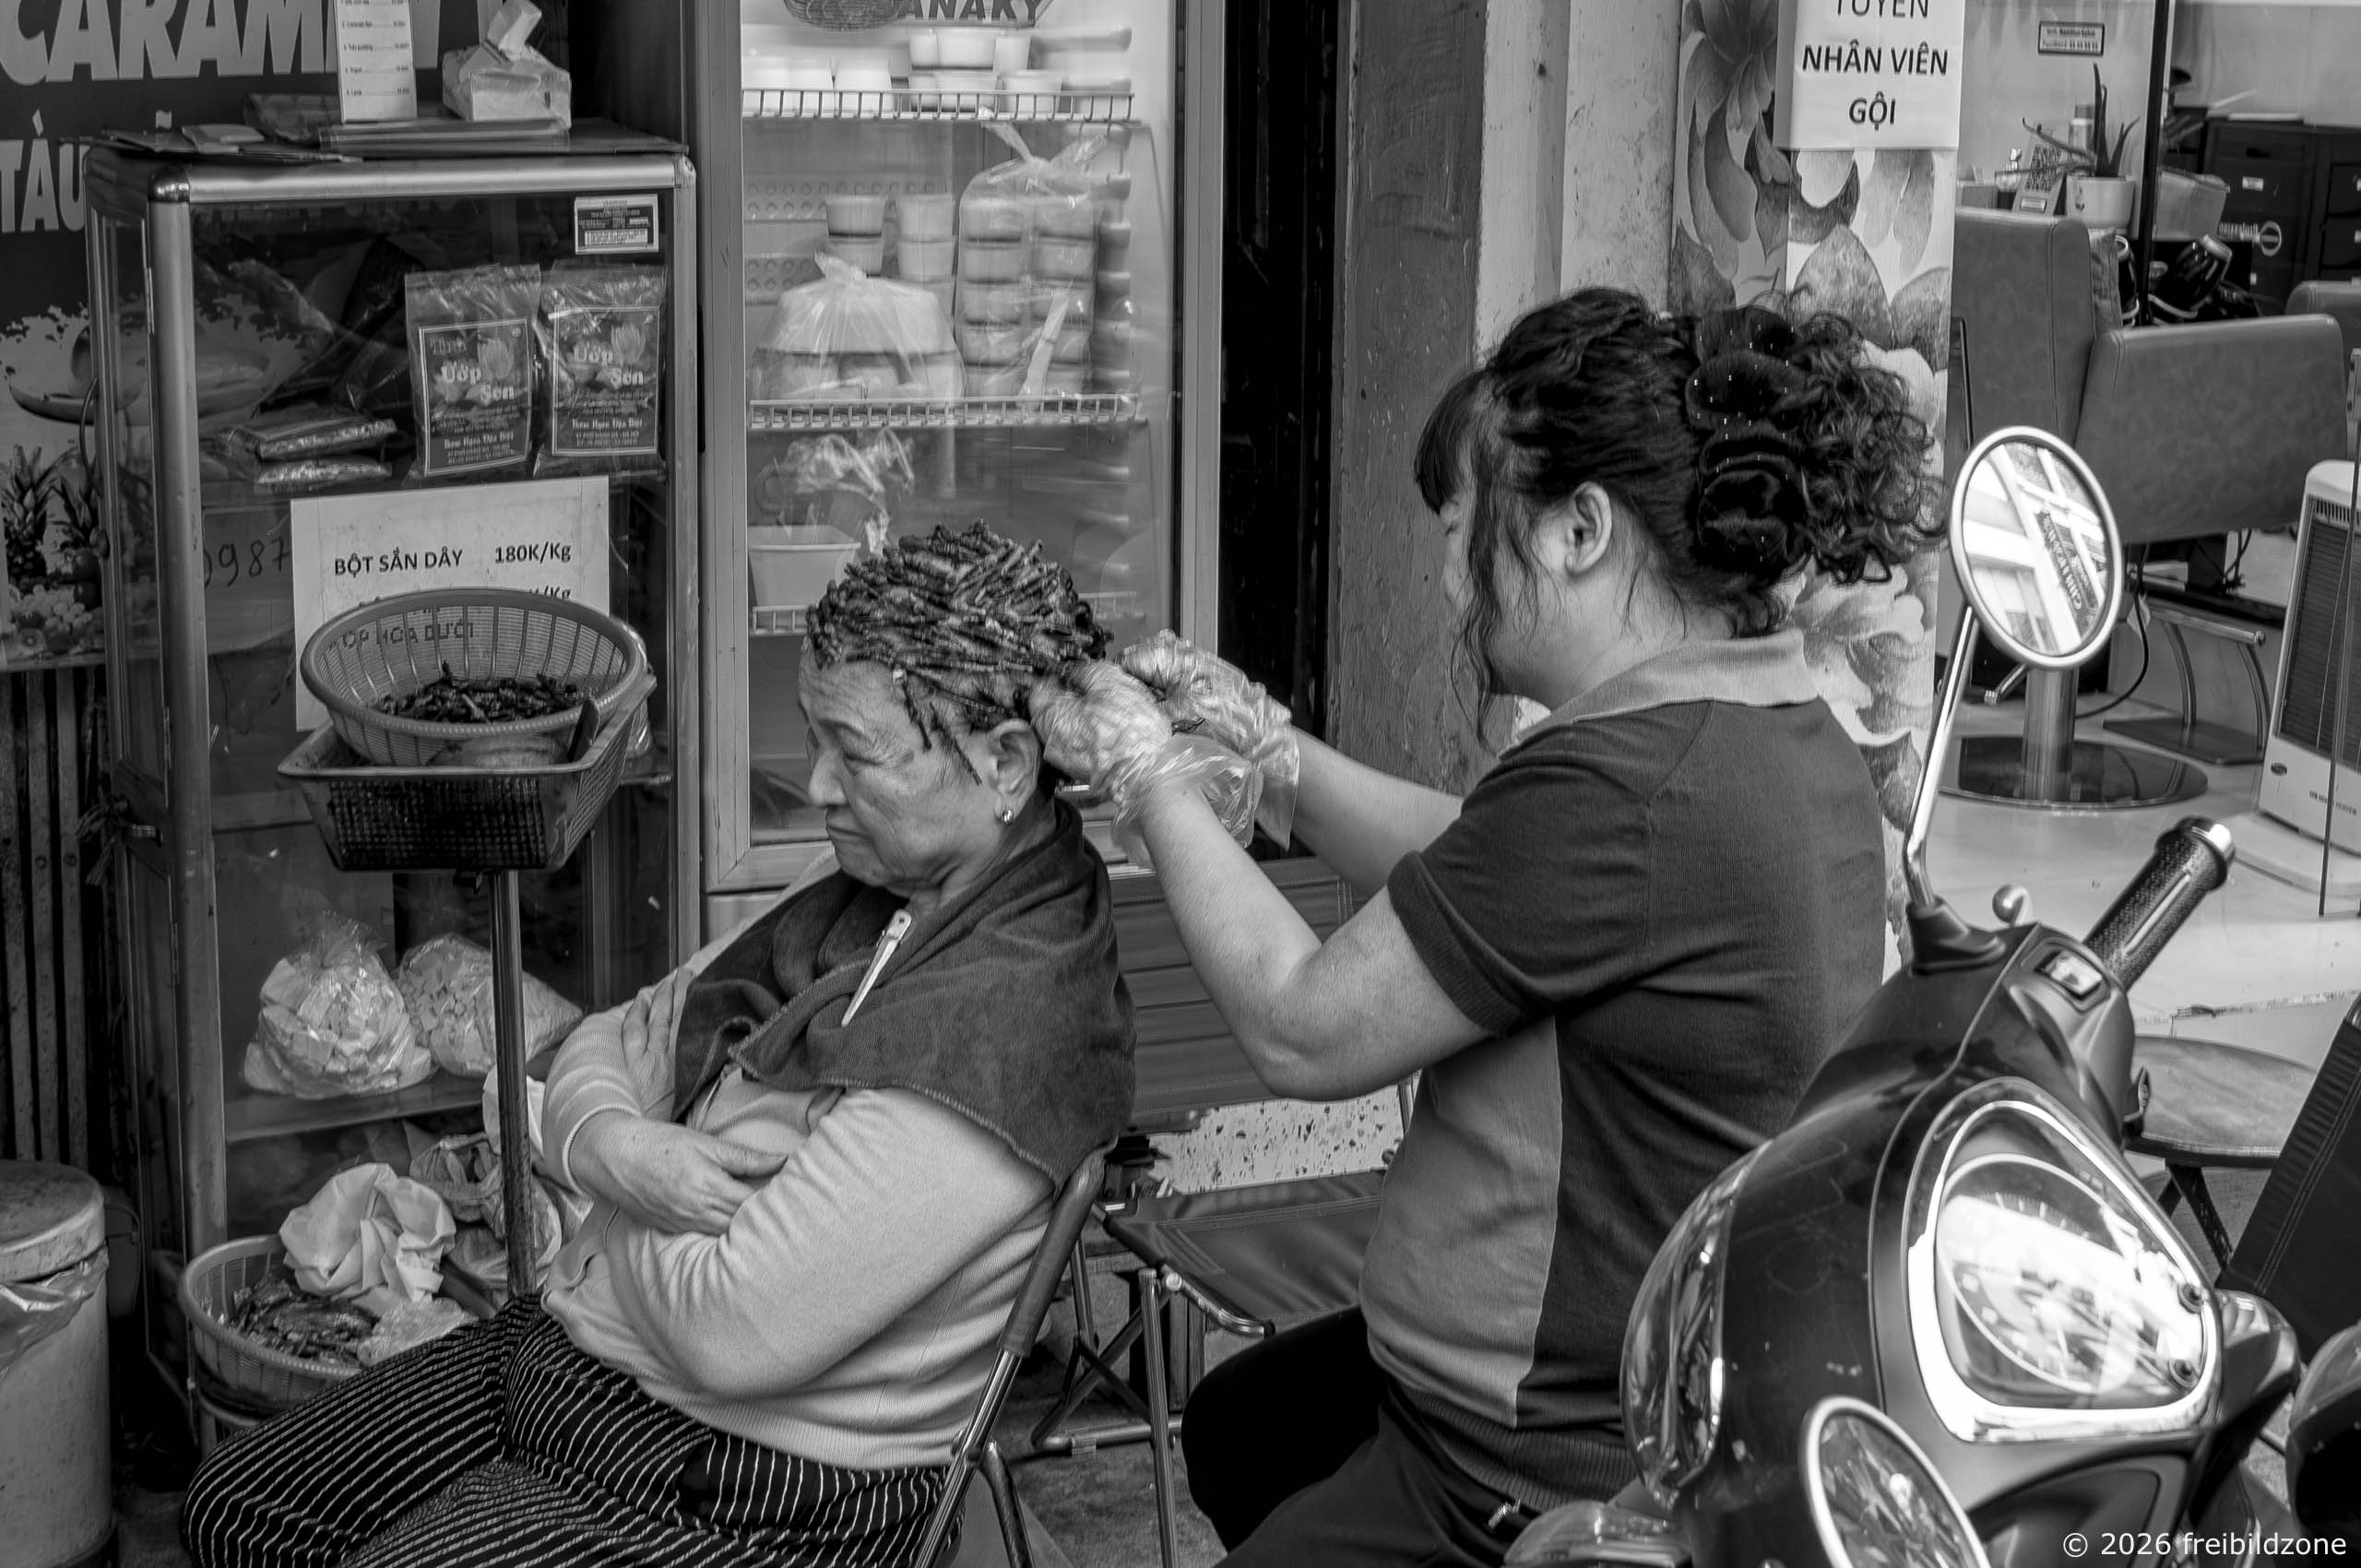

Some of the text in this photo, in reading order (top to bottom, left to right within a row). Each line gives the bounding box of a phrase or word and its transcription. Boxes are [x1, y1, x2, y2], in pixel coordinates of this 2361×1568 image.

[1802, 39, 1948, 76] NHÂN VIÊN
[1849, 90, 1896, 132] GỘI
[335, 541, 572, 578] BỘT SẮN DÂY 180K/Kg
